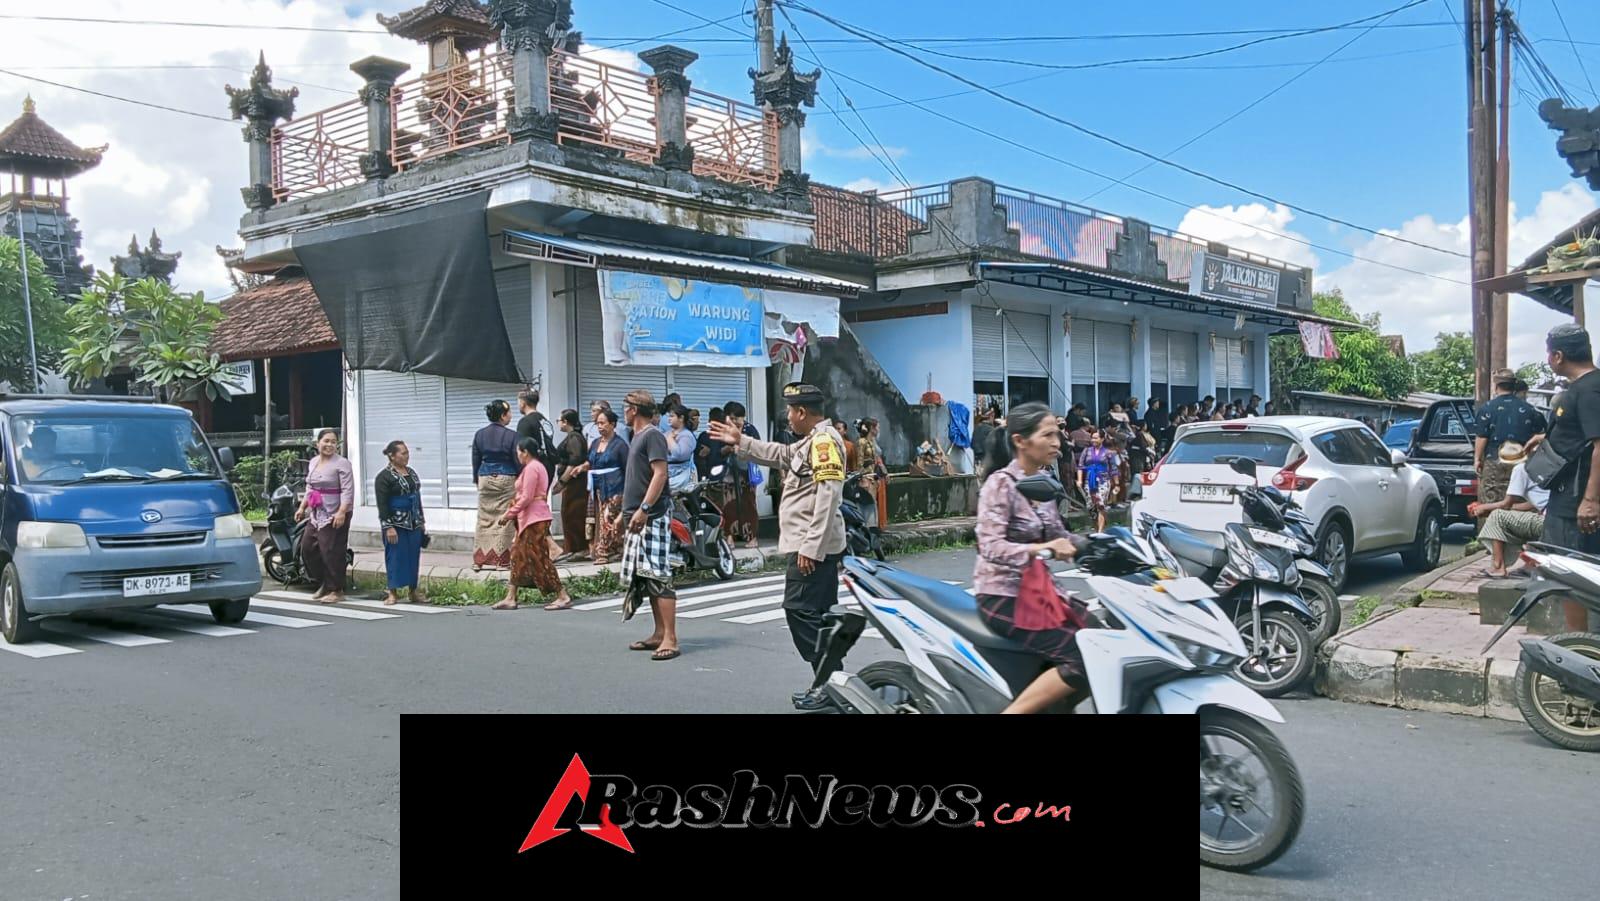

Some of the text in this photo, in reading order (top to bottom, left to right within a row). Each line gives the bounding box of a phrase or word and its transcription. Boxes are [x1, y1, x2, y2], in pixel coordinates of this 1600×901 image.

[688, 303, 750, 321] WARUNG
[705, 325, 737, 342] WIDI
[126, 580, 139, 590] DK
[176, 575, 189, 586] AE
